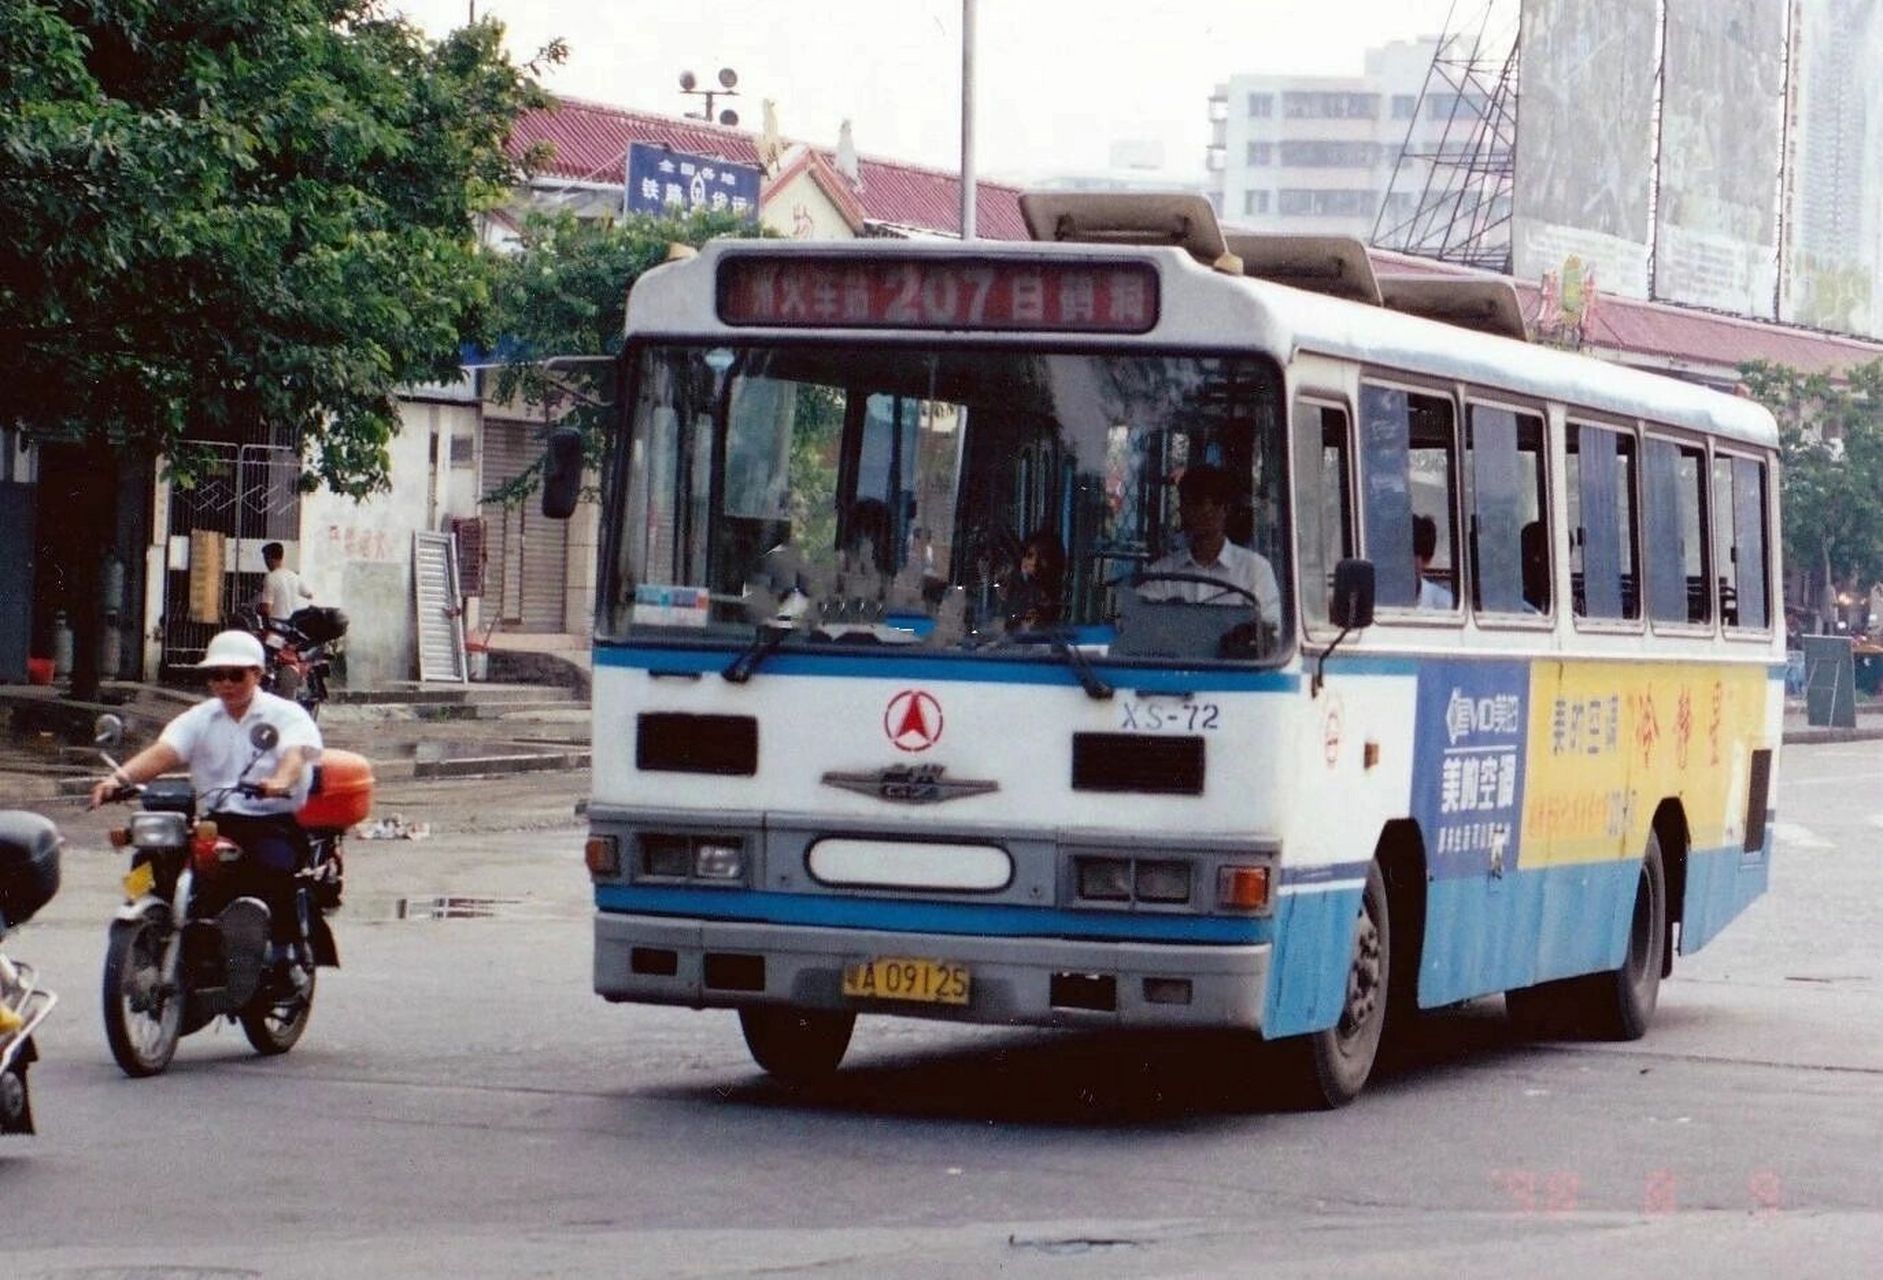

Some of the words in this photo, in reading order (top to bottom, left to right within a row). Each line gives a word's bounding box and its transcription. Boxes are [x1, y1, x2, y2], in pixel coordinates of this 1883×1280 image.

[884, 266, 996, 322] 207
[1122, 702, 1219, 730] XS-72
[886, 963, 967, 997] 09125
